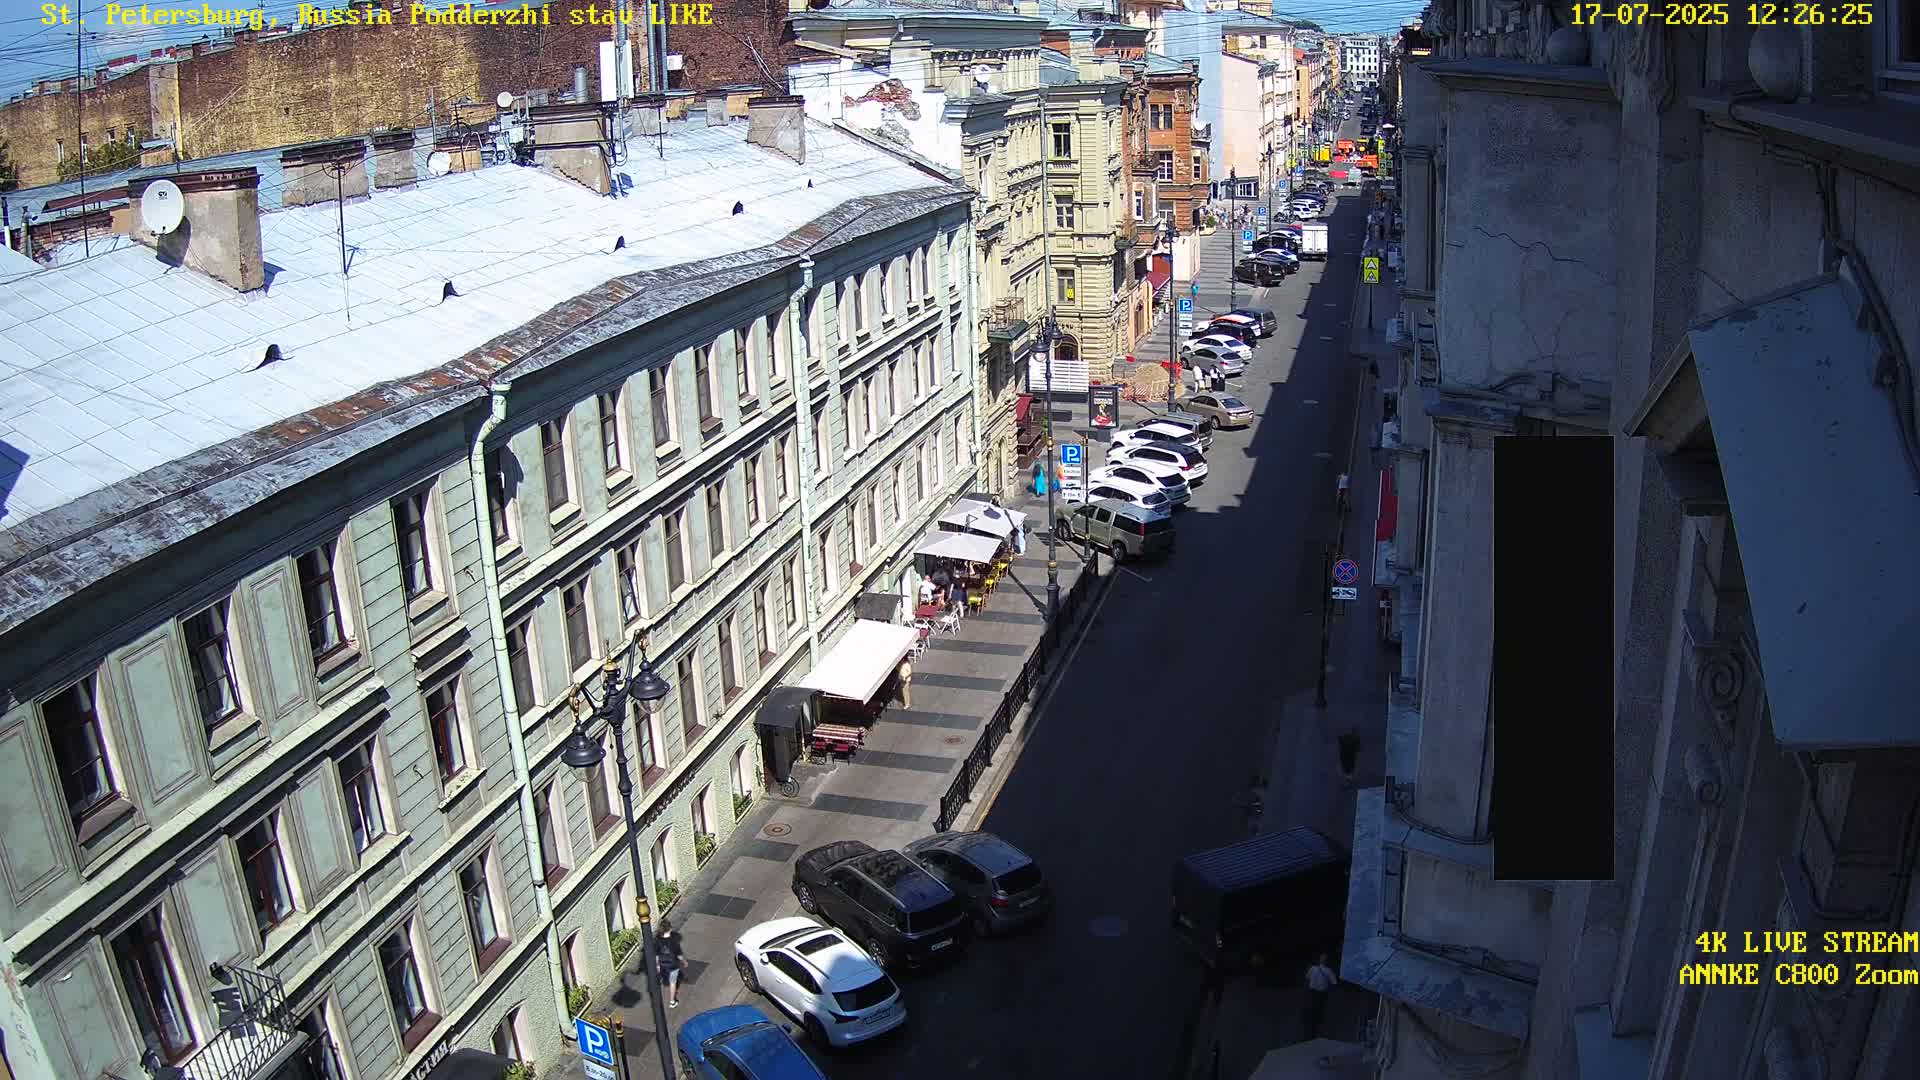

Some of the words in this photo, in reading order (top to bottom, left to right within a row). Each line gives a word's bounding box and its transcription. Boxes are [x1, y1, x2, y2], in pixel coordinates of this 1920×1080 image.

[1182, 300, 1191, 311] P
[1066, 446, 1078, 462] P
[583, 1024, 604, 1053] P
